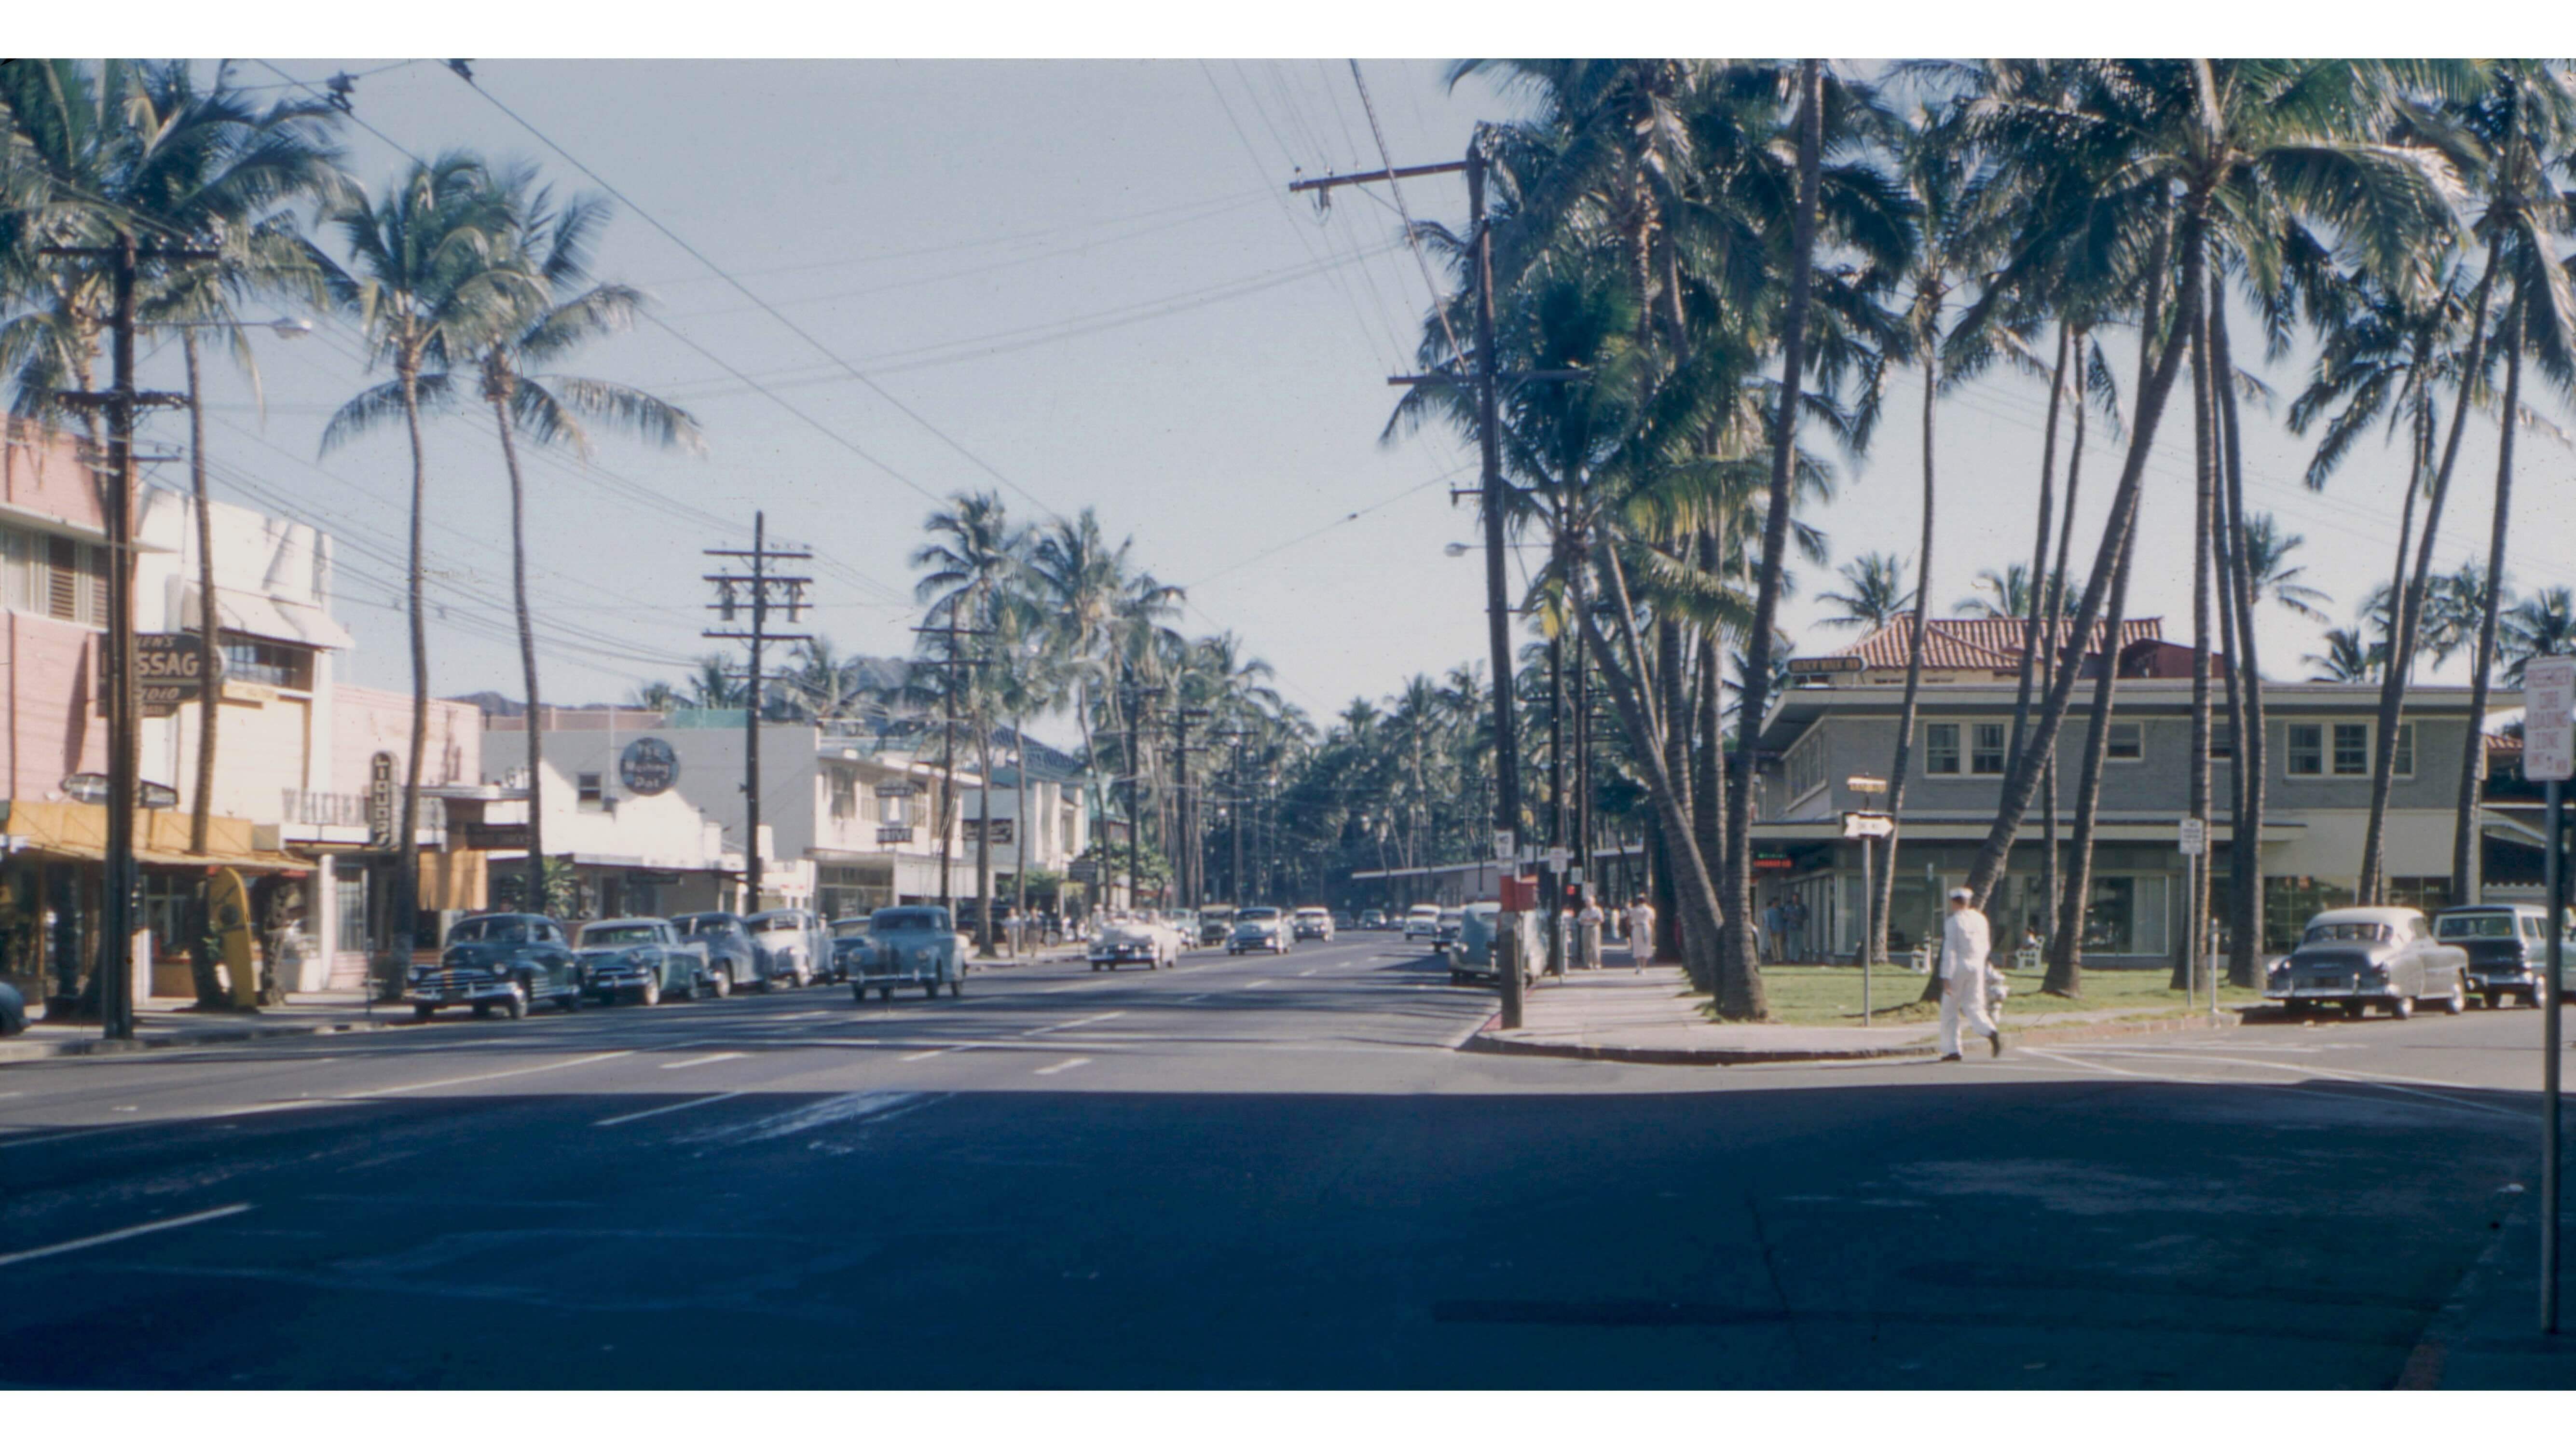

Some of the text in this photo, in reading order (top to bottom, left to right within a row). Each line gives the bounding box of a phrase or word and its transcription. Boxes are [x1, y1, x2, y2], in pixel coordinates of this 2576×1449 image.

[138, 652, 199, 676] SSAG
[2527, 711, 2568, 730] LOADING
[2535, 731, 2560, 749] ZONE
[634, 777, 659, 788] Pot
